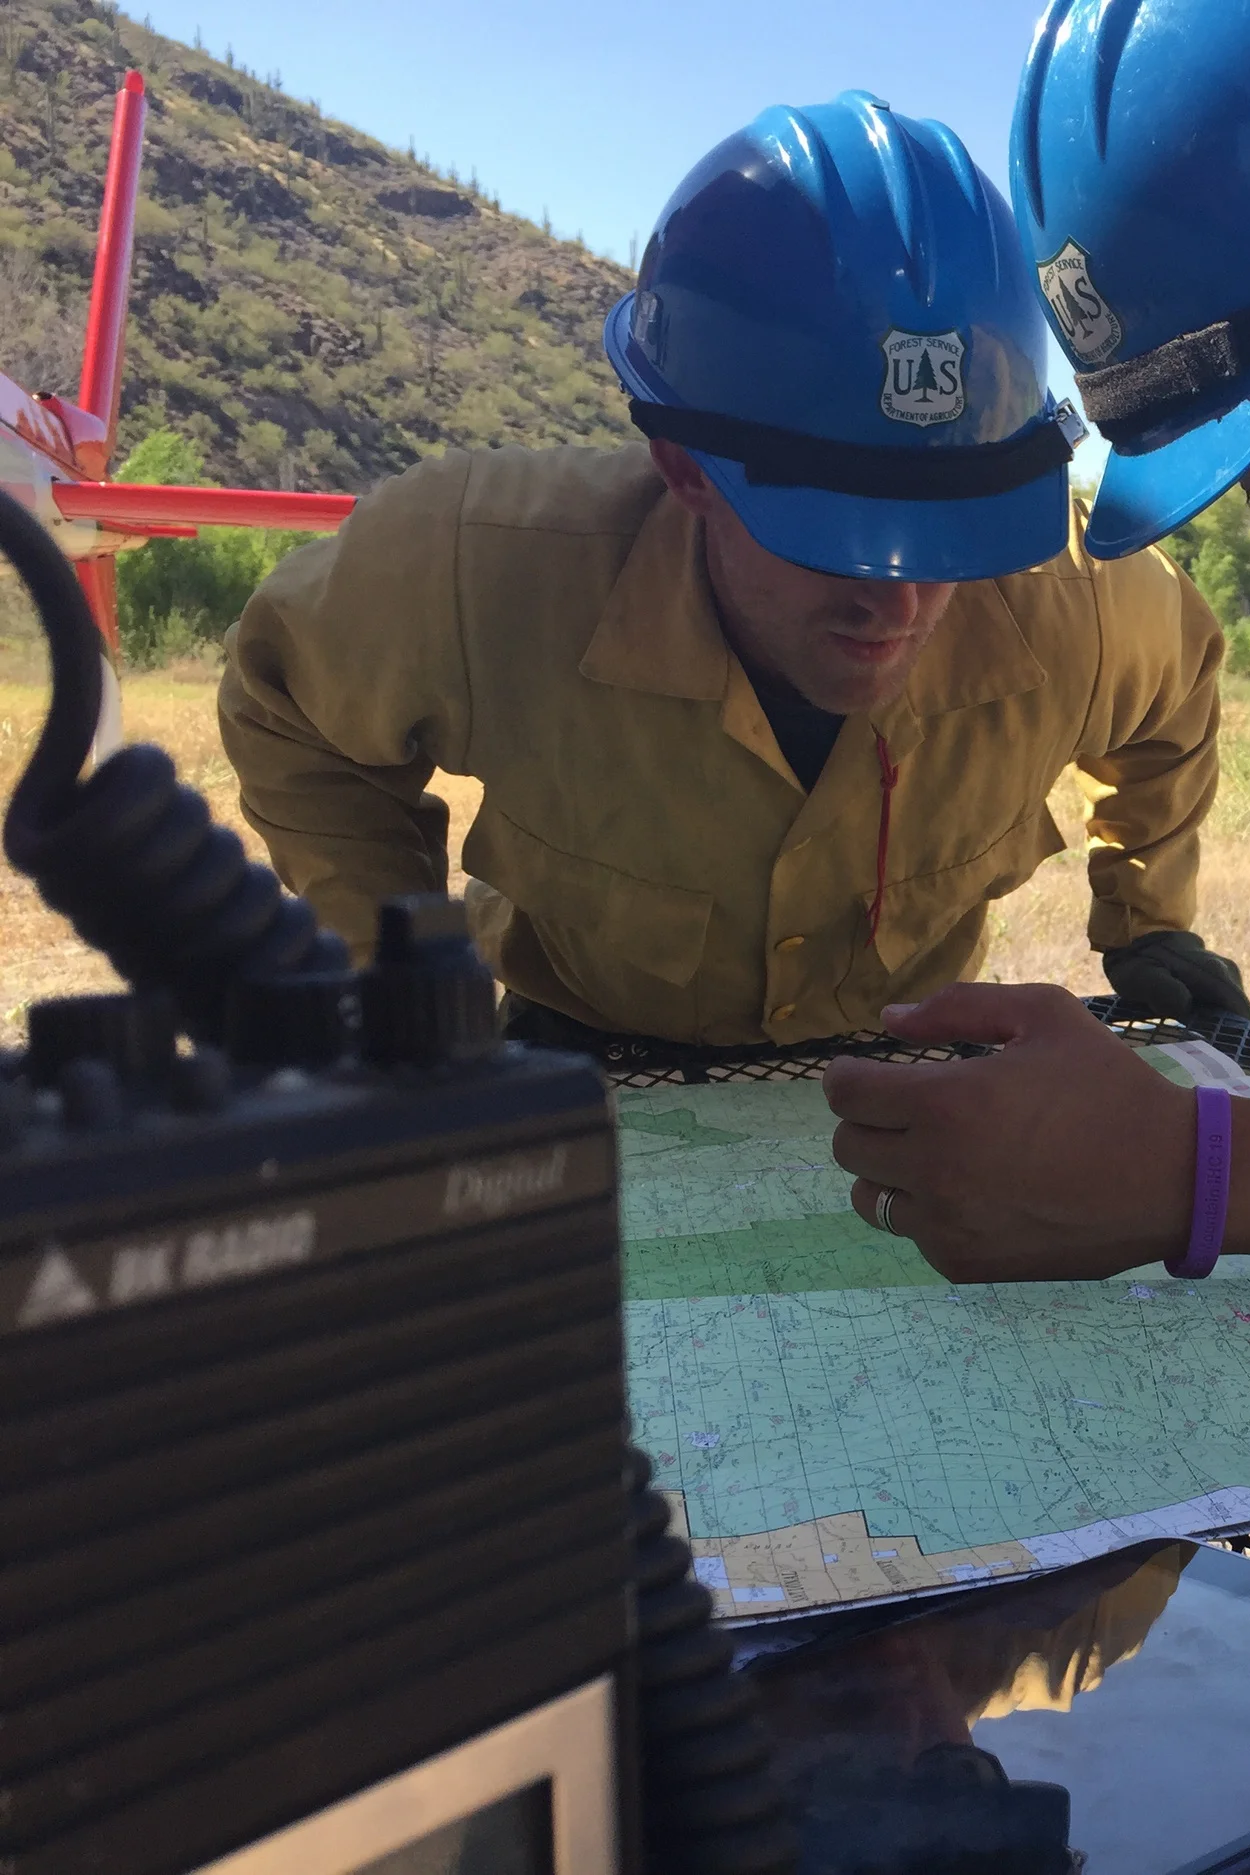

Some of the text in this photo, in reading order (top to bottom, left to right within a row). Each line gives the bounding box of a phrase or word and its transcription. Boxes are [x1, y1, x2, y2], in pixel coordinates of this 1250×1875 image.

[1055, 258, 1084, 273] SERVICE
[889, 338, 960, 357] FOREST SERVICE
[883, 393, 963, 421] DEPARTMENT OF AGRICULTURE
